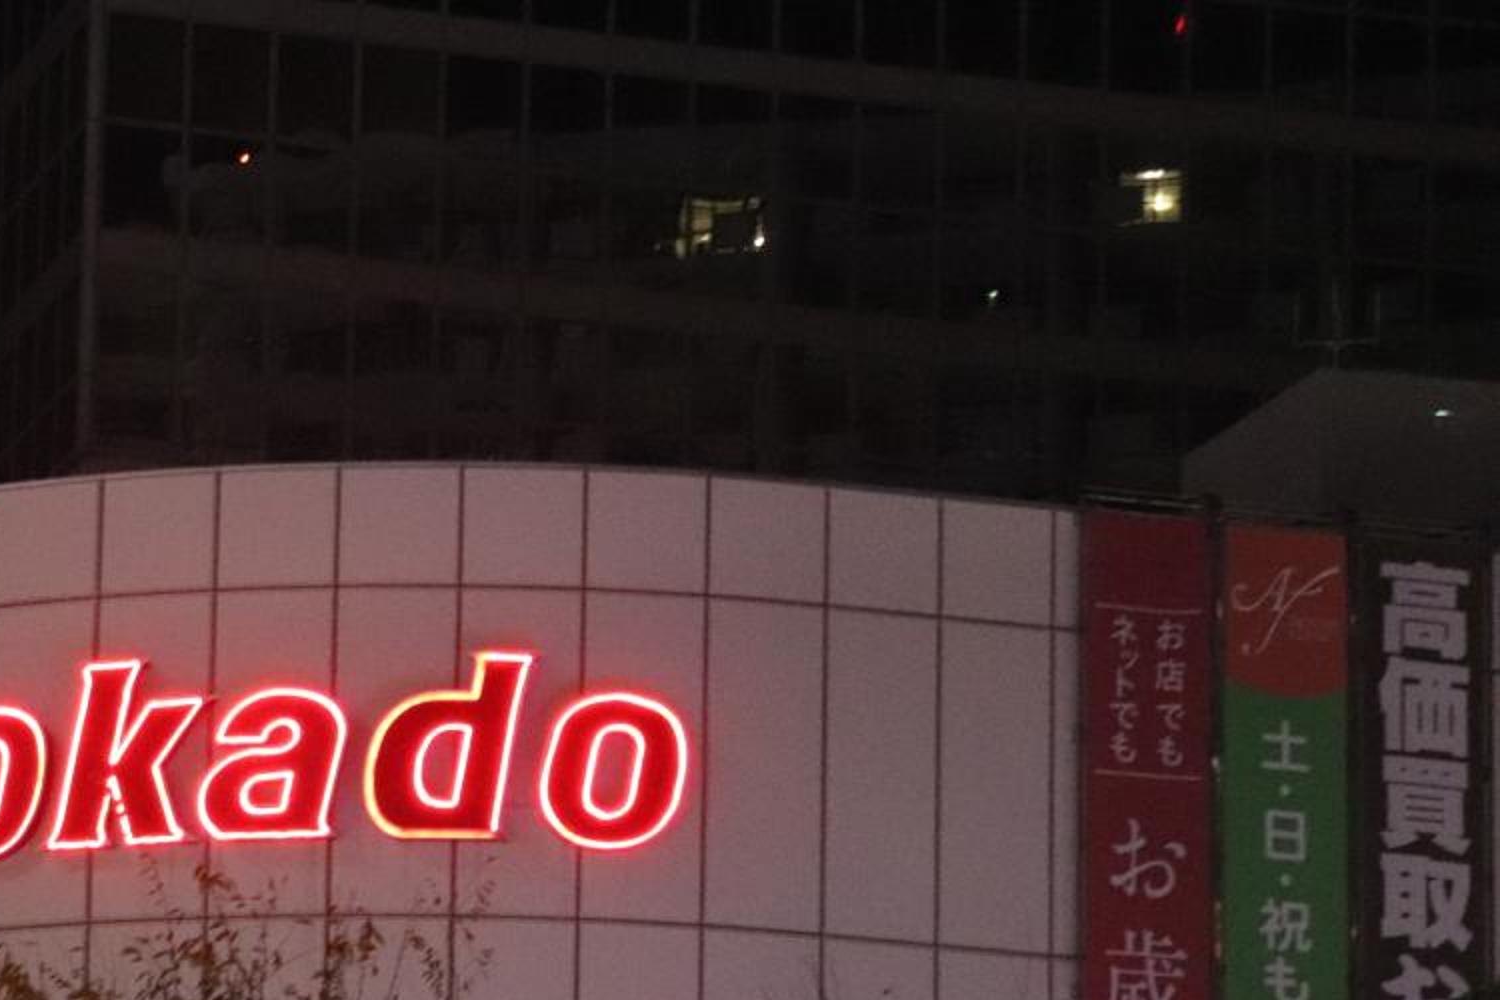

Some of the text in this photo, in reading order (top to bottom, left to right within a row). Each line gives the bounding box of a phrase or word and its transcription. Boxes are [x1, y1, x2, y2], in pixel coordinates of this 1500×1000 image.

[1108, 613, 1140, 764] ネットでも
[1155, 618, 1187, 767] お店でも
